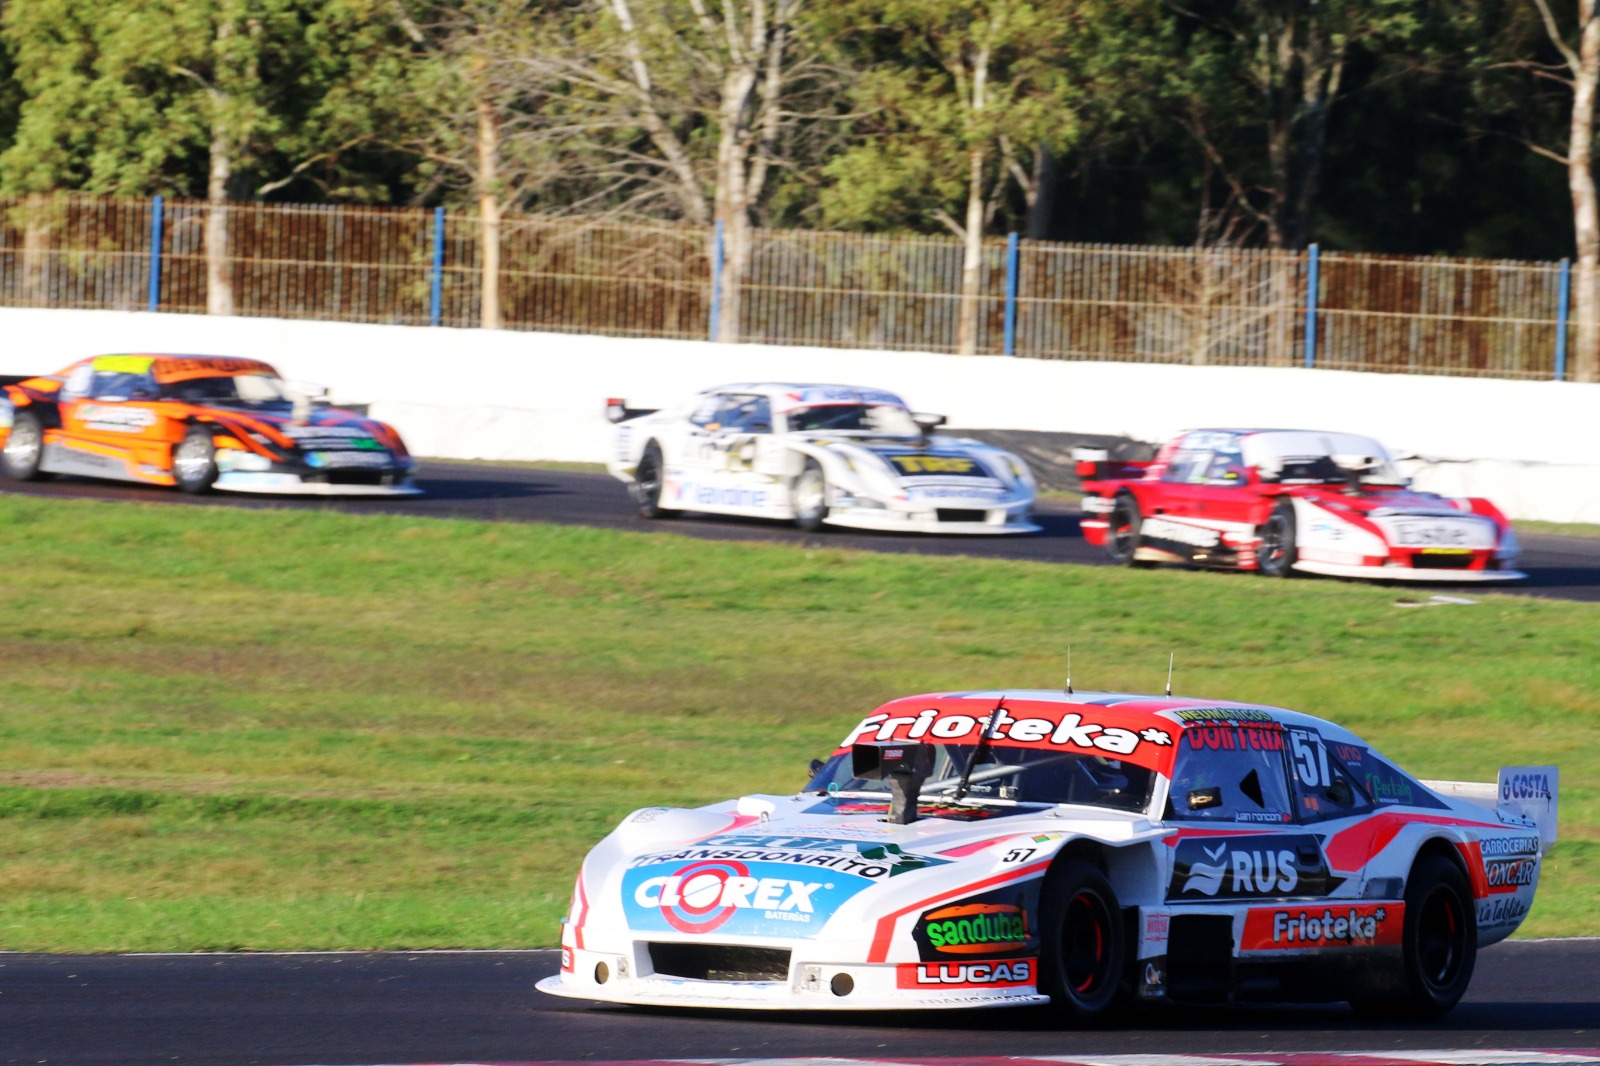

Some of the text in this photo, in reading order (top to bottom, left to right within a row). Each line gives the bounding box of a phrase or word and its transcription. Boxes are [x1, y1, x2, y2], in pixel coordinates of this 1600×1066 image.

[1290, 728, 1331, 787] 57
[1512, 774, 1550, 799] COSTA
[1003, 848, 1037, 863] 57
[1231, 850, 1299, 893] RUS
[926, 912, 1026, 948] sanduba
[916, 961, 1030, 984] LUCAS
